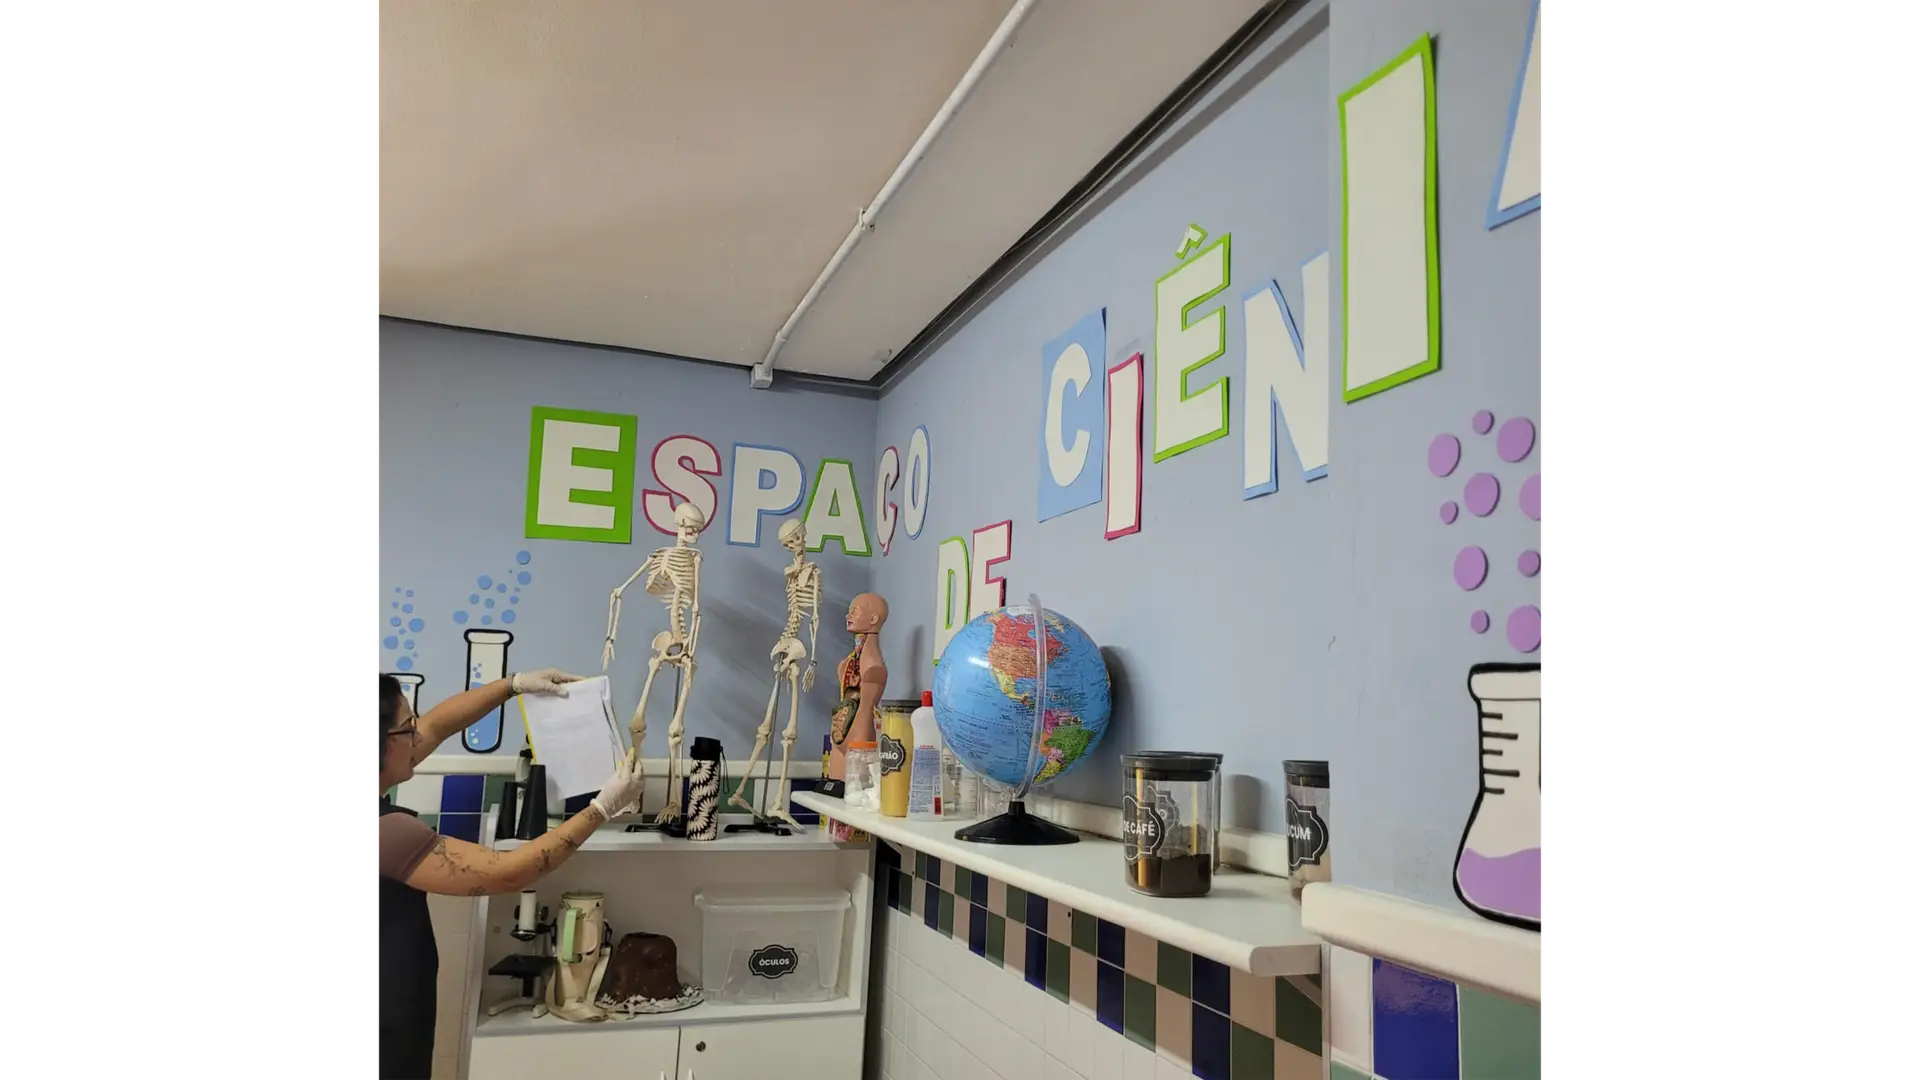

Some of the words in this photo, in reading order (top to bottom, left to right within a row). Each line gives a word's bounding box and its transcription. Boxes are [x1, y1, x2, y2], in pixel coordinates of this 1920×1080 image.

[526, 407, 930, 557] ESPAÇO
[1130, 819, 1156, 836] CAFÉ
[758, 957, 790, 967] ÓCULOS
